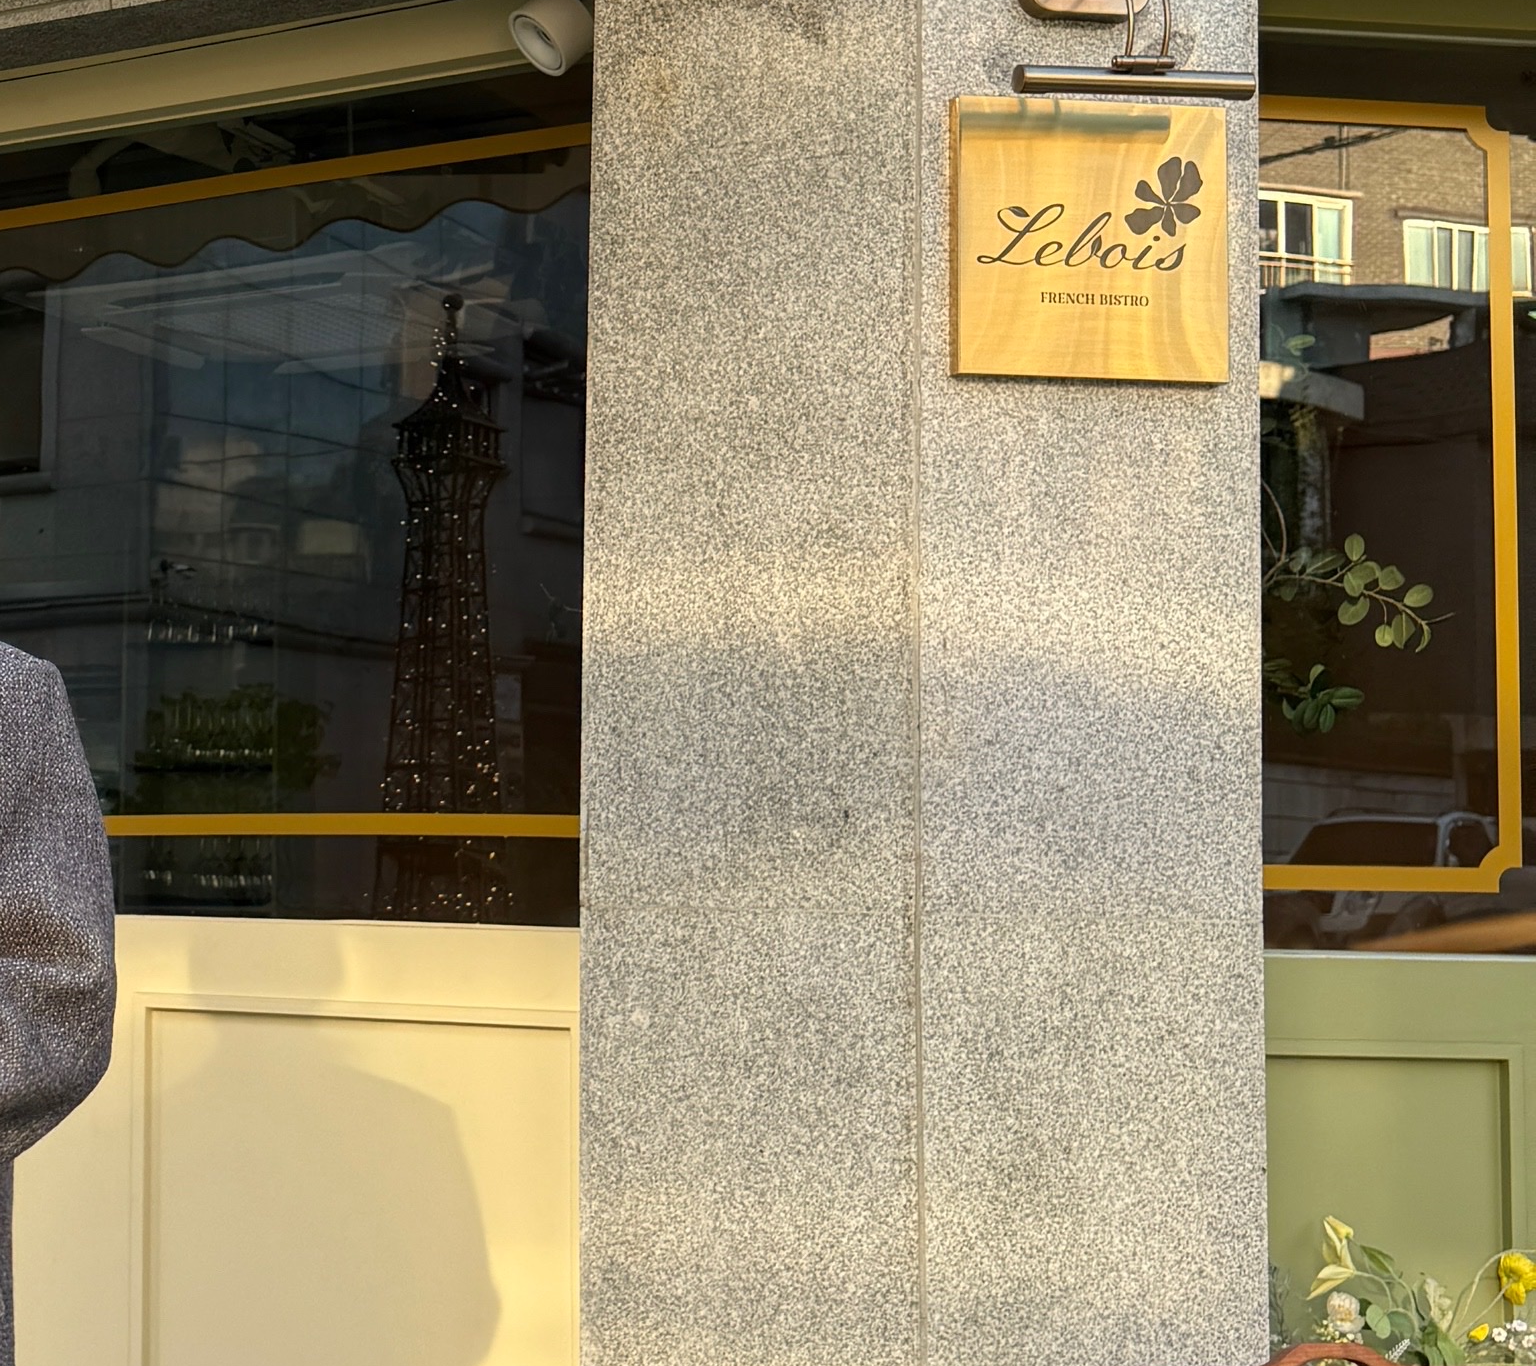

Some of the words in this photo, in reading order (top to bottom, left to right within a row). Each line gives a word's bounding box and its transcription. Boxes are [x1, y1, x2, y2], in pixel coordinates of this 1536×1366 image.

[976, 203, 1187, 271] Lebois
[1040, 291, 1095, 305] FRENCH
[1099, 293, 1150, 307] BISTRO
